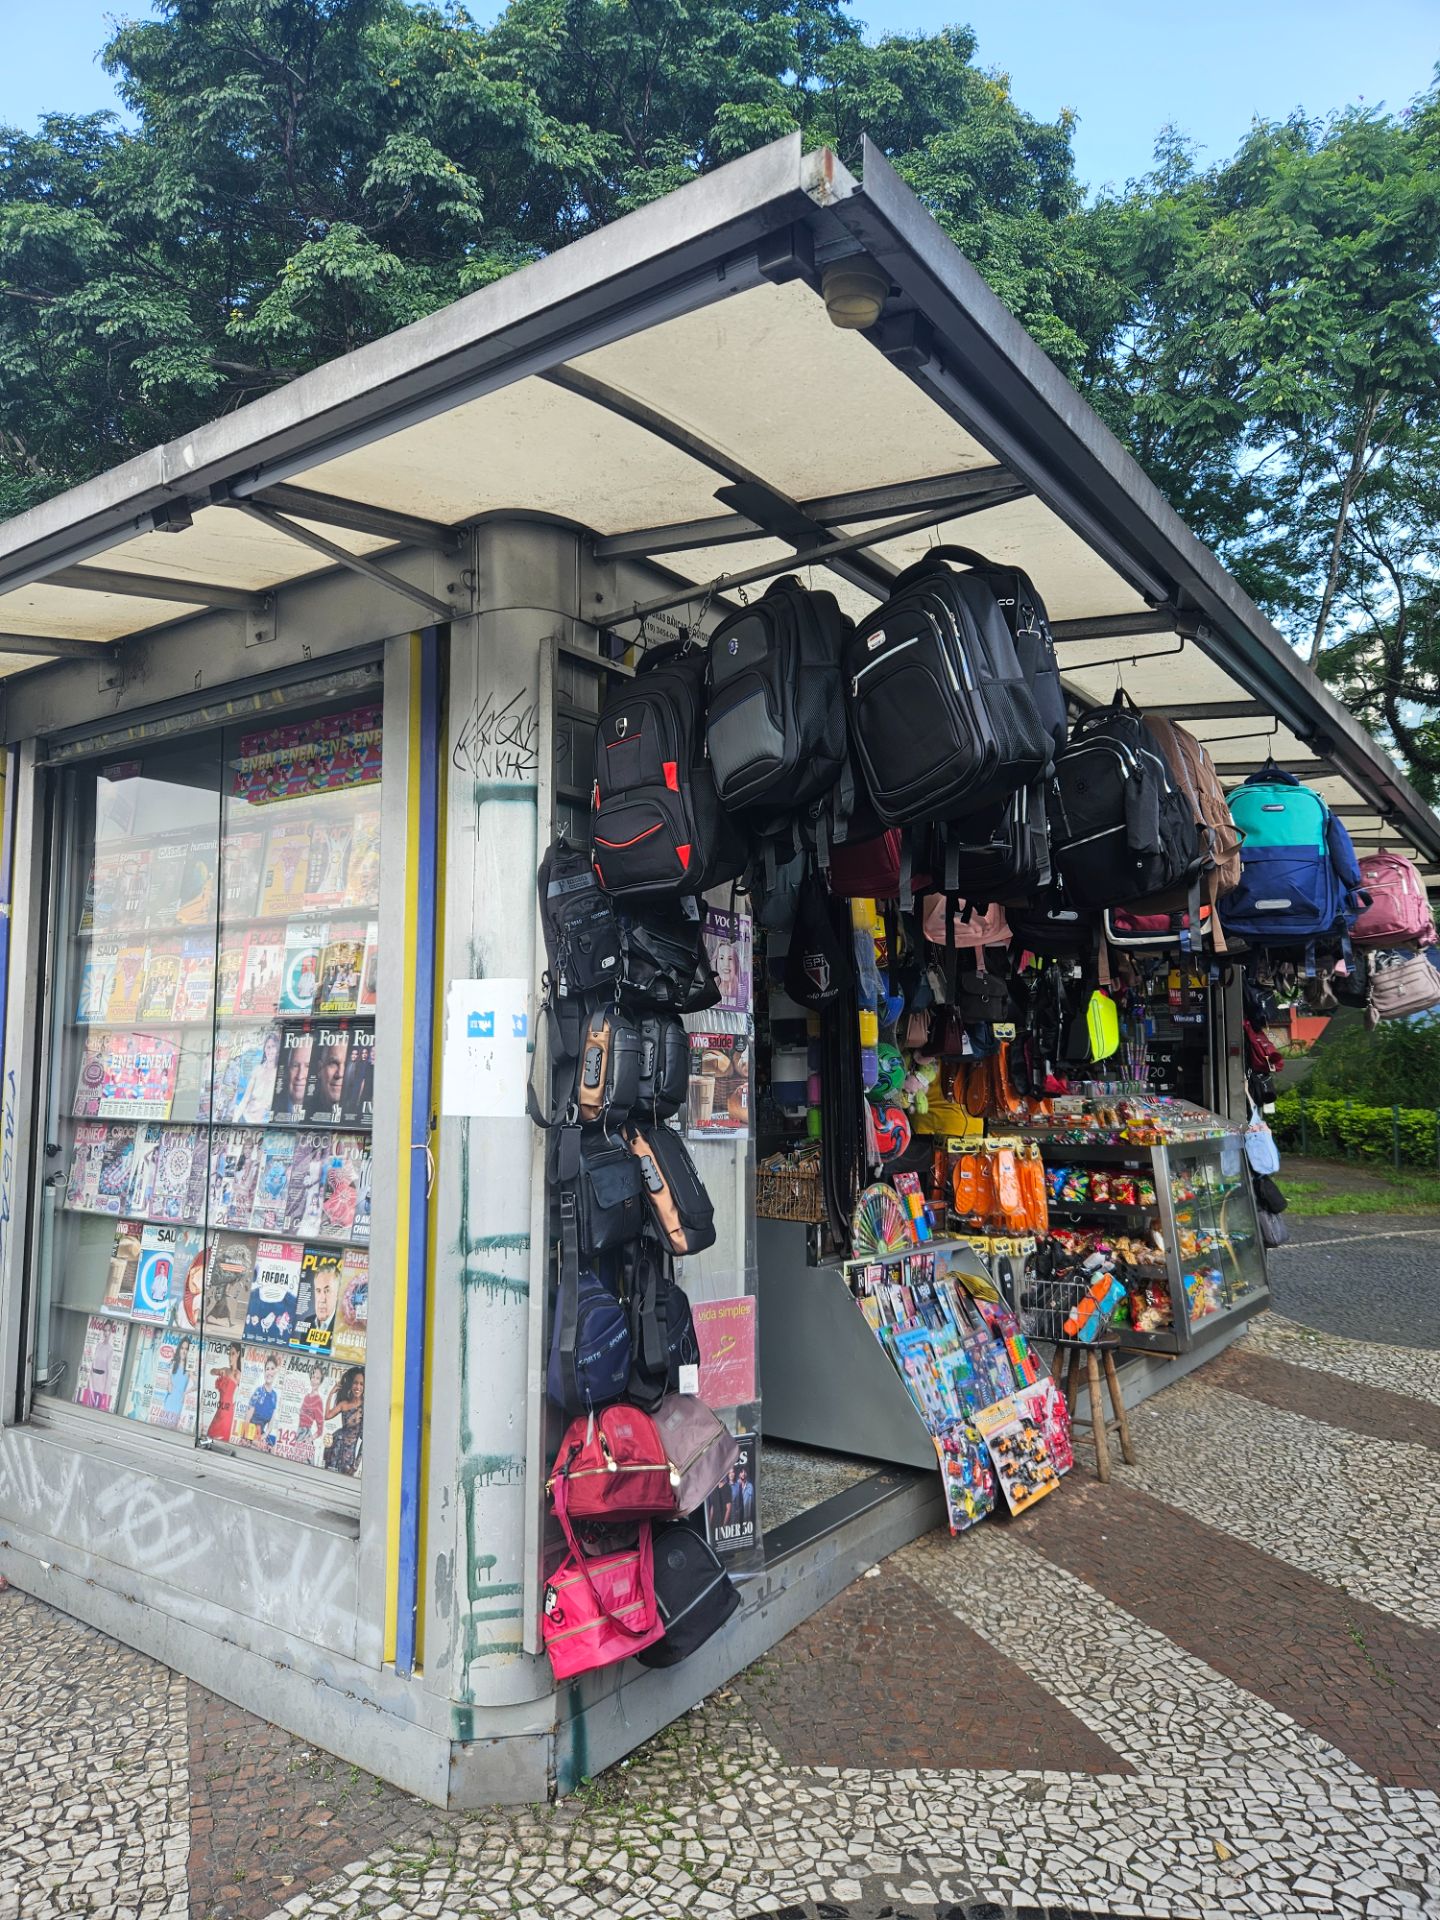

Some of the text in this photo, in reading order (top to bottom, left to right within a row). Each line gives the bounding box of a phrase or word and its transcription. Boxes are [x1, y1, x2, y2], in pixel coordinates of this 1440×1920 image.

[1150, 1066, 1165, 1078] 20
[257, 1242, 283, 1254] SUPER
[718, 1303, 751, 1319] simples
[309, 1329, 328, 1344] HEXA
[277, 1428, 297, 1447] 142
[714, 1524, 741, 1540] UNDER
